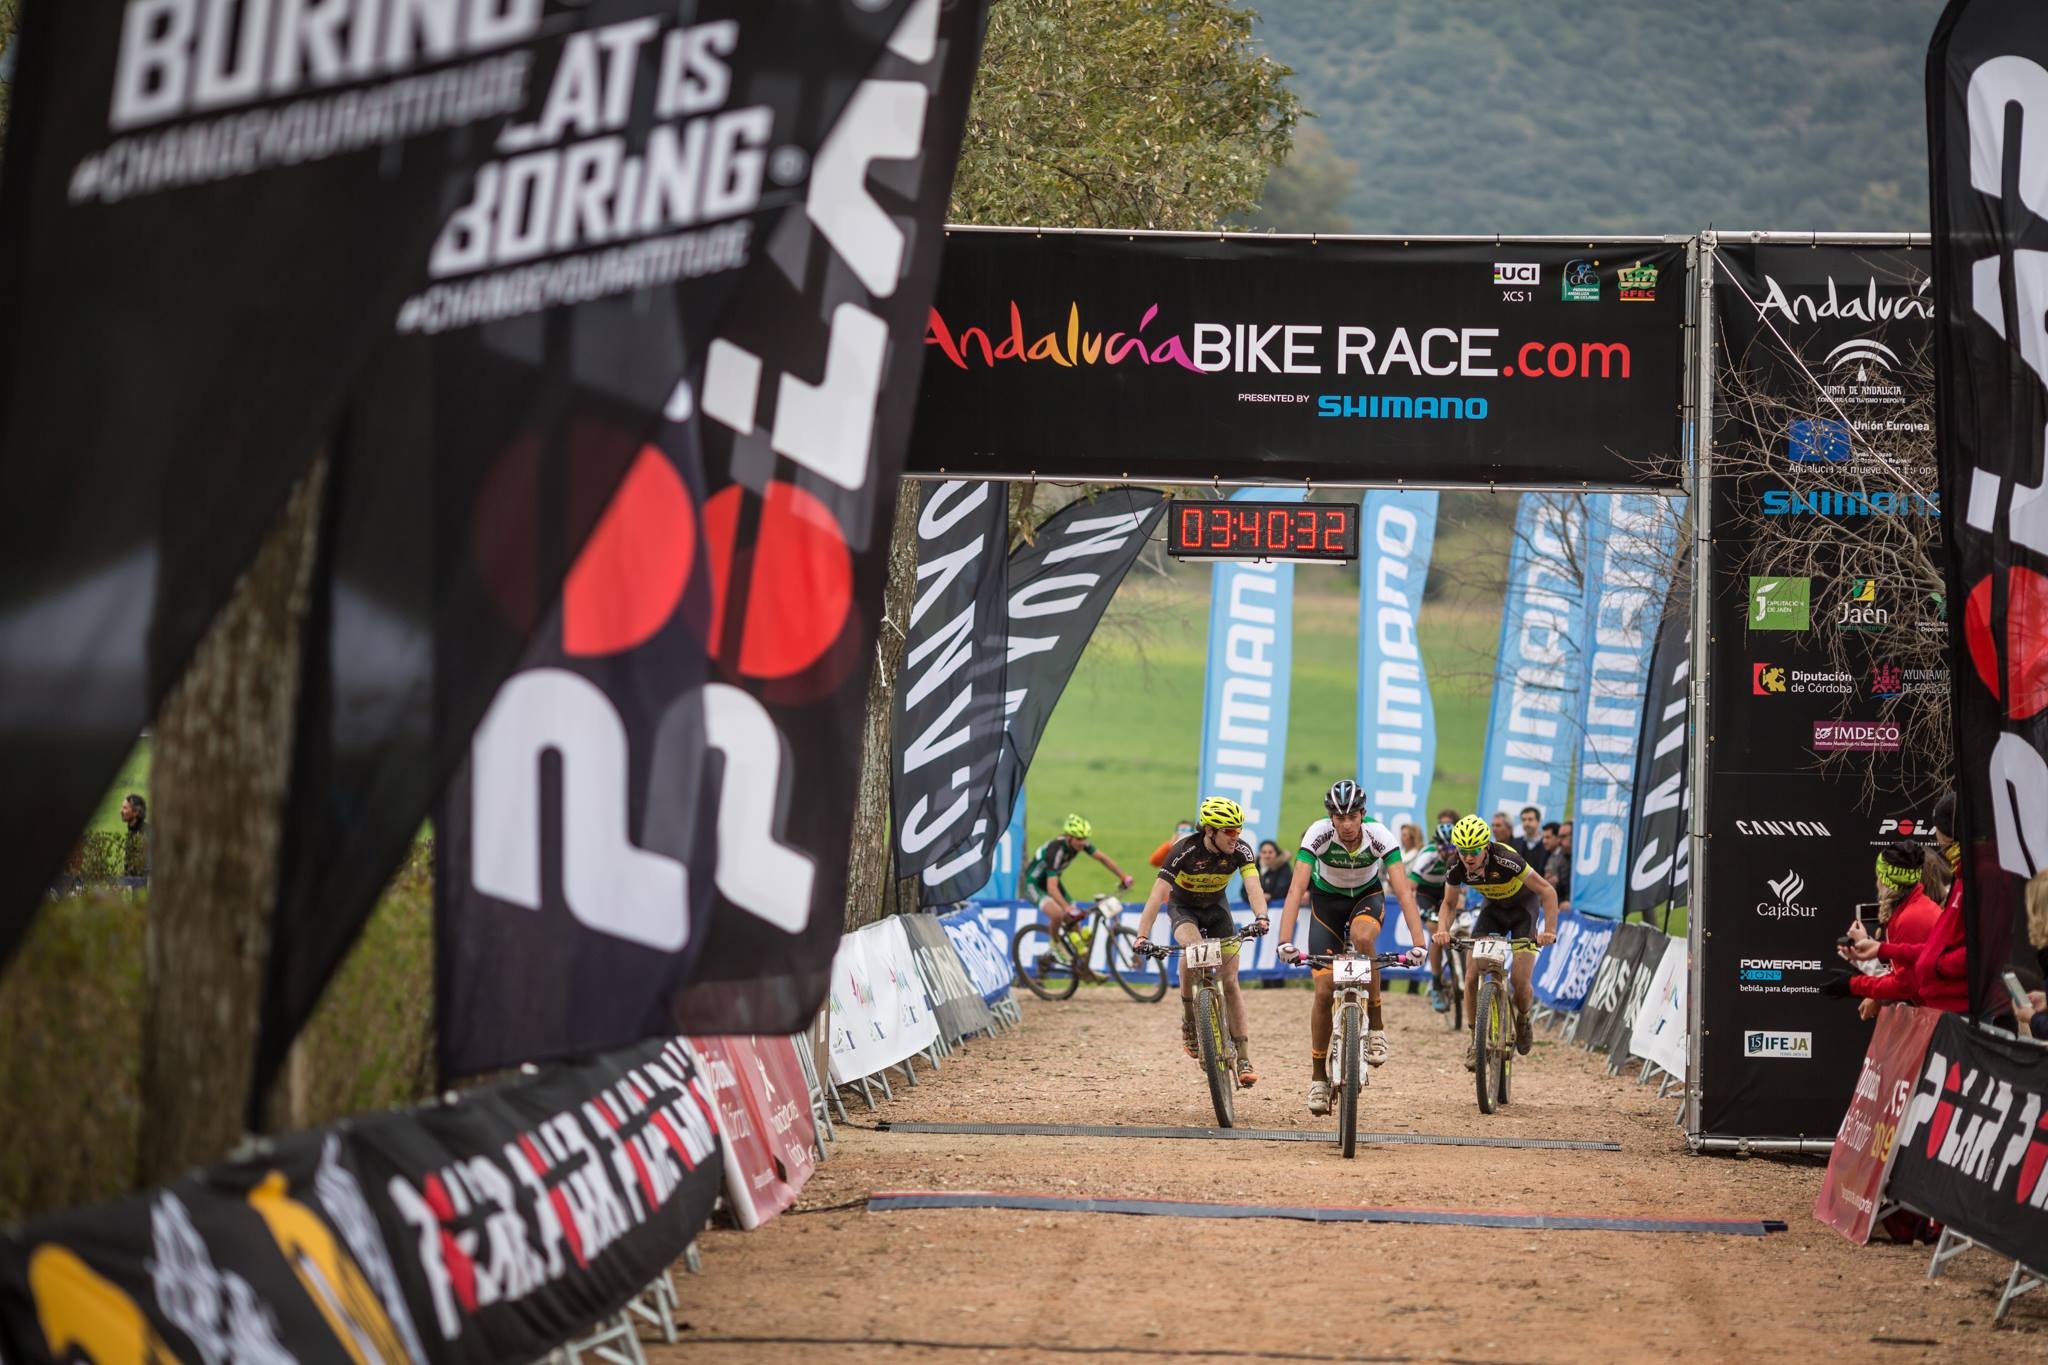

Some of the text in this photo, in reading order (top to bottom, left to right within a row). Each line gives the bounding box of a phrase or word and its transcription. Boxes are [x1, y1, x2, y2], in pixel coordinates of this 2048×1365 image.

[655, 20, 738, 117] IS
[428, 105, 775, 278] BORING
[1502, 267, 1536, 281] UCI
[1502, 291, 1532, 301] XCS 1
[1620, 290, 1655, 298] RFEC
[1194, 323, 1323, 375] BIKE
[1848, 386, 1859, 395] DE
[1238, 393, 1488, 420] PRESENTED BY SHIMANO
[1182, 508, 1345, 550] 03:40:32
[1838, 601, 1888, 624] Jaén
[1791, 671, 1852, 683] Diputación
[1791, 682, 1853, 694] de Córdoba
[1213, 561, 1279, 850] HIMAN
[1834, 727, 1899, 741] IMDECO
[1735, 819, 1832, 837] CANYON
[1756, 902, 1818, 920] CajaSur
[1192, 944, 1208, 962] 17
[1480, 941, 1496, 954] 17
[1344, 961, 1354, 976] 4
[1740, 959, 1823, 970] POWERADE
[1740, 984, 1764, 992] bebida
[1765, 986, 1781, 994] para
[1765, 1037, 1809, 1051] IFEJA
